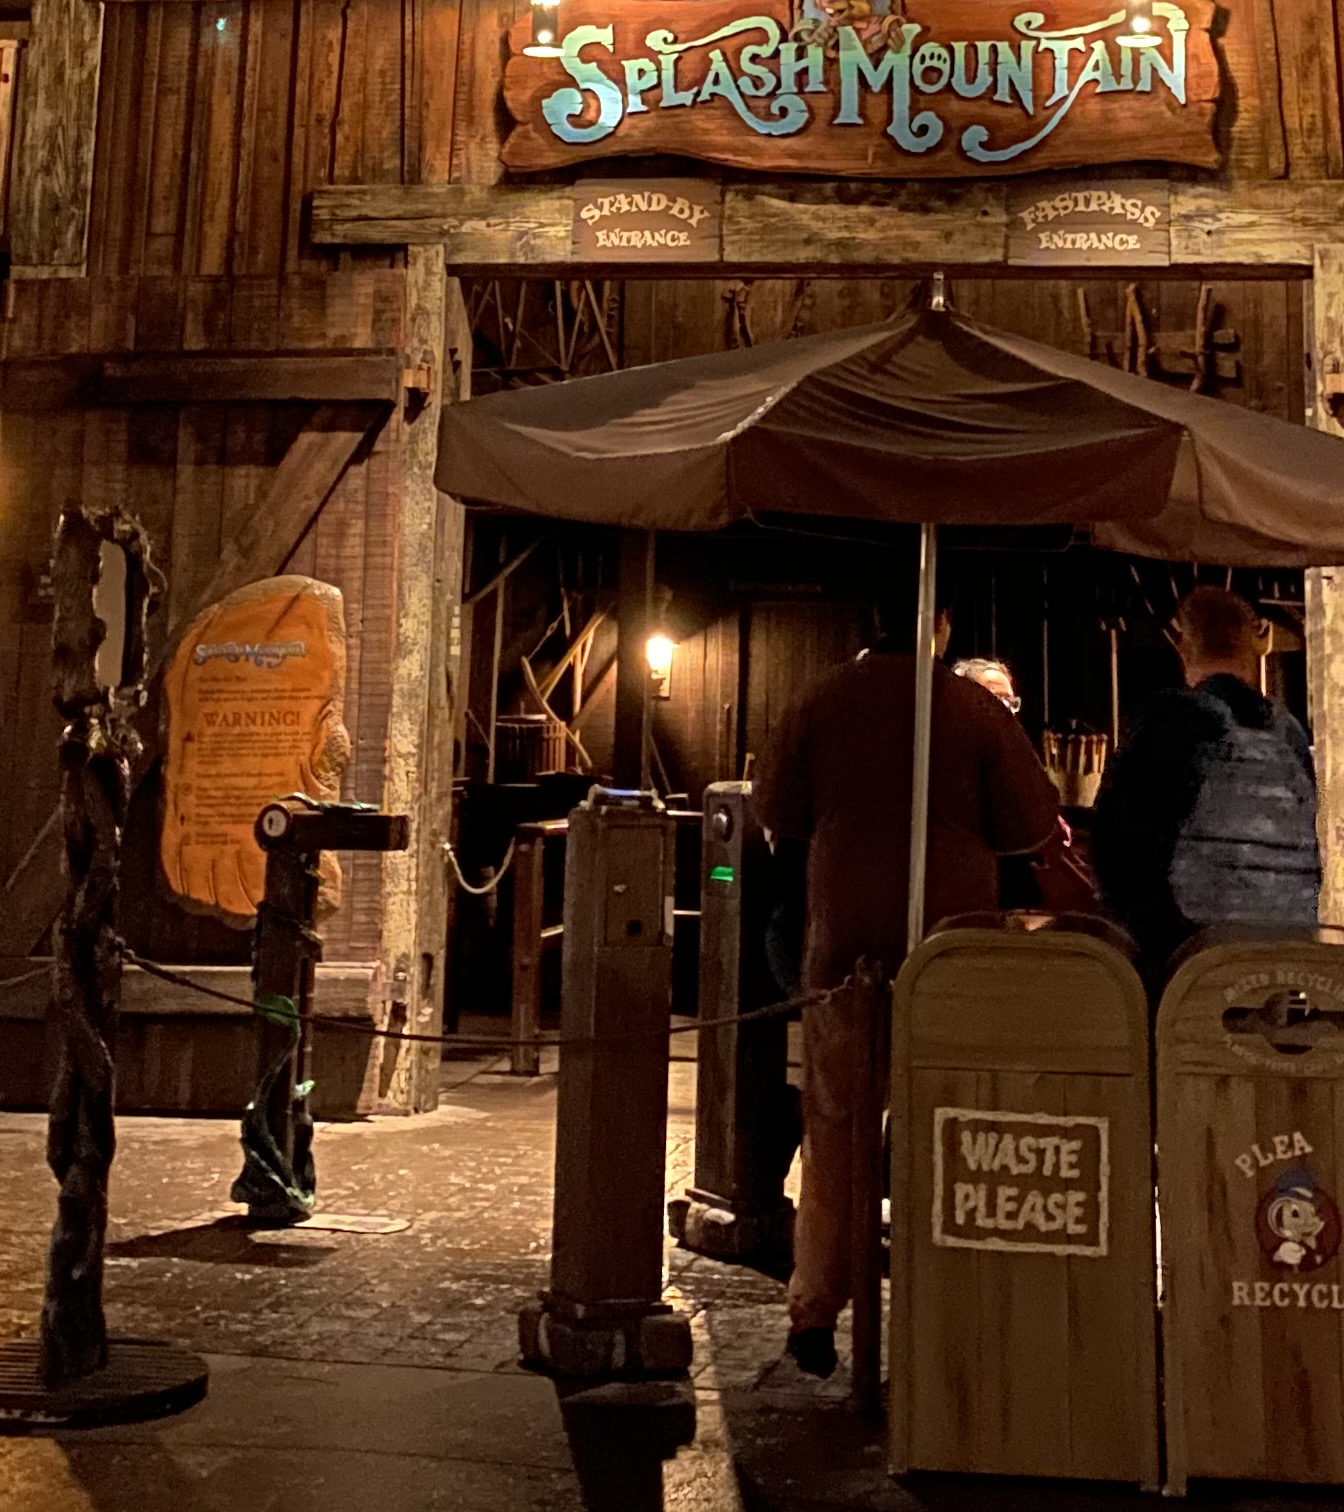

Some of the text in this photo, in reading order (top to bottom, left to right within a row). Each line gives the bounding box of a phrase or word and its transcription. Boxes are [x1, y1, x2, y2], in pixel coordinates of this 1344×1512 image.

[542, 1, 1188, 162] SPLASH MOUNTAIN
[580, 191, 711, 228] STAND-BY
[1017, 190, 1162, 231] FASTPASS
[595, 227, 692, 248] ENTRANCE
[1038, 229, 1141, 251] ENTRANCE
[203, 711, 302, 728] WARNING!
[960, 1129, 1083, 1179] WASTE
[954, 1182, 1088, 1234] PLEASE
